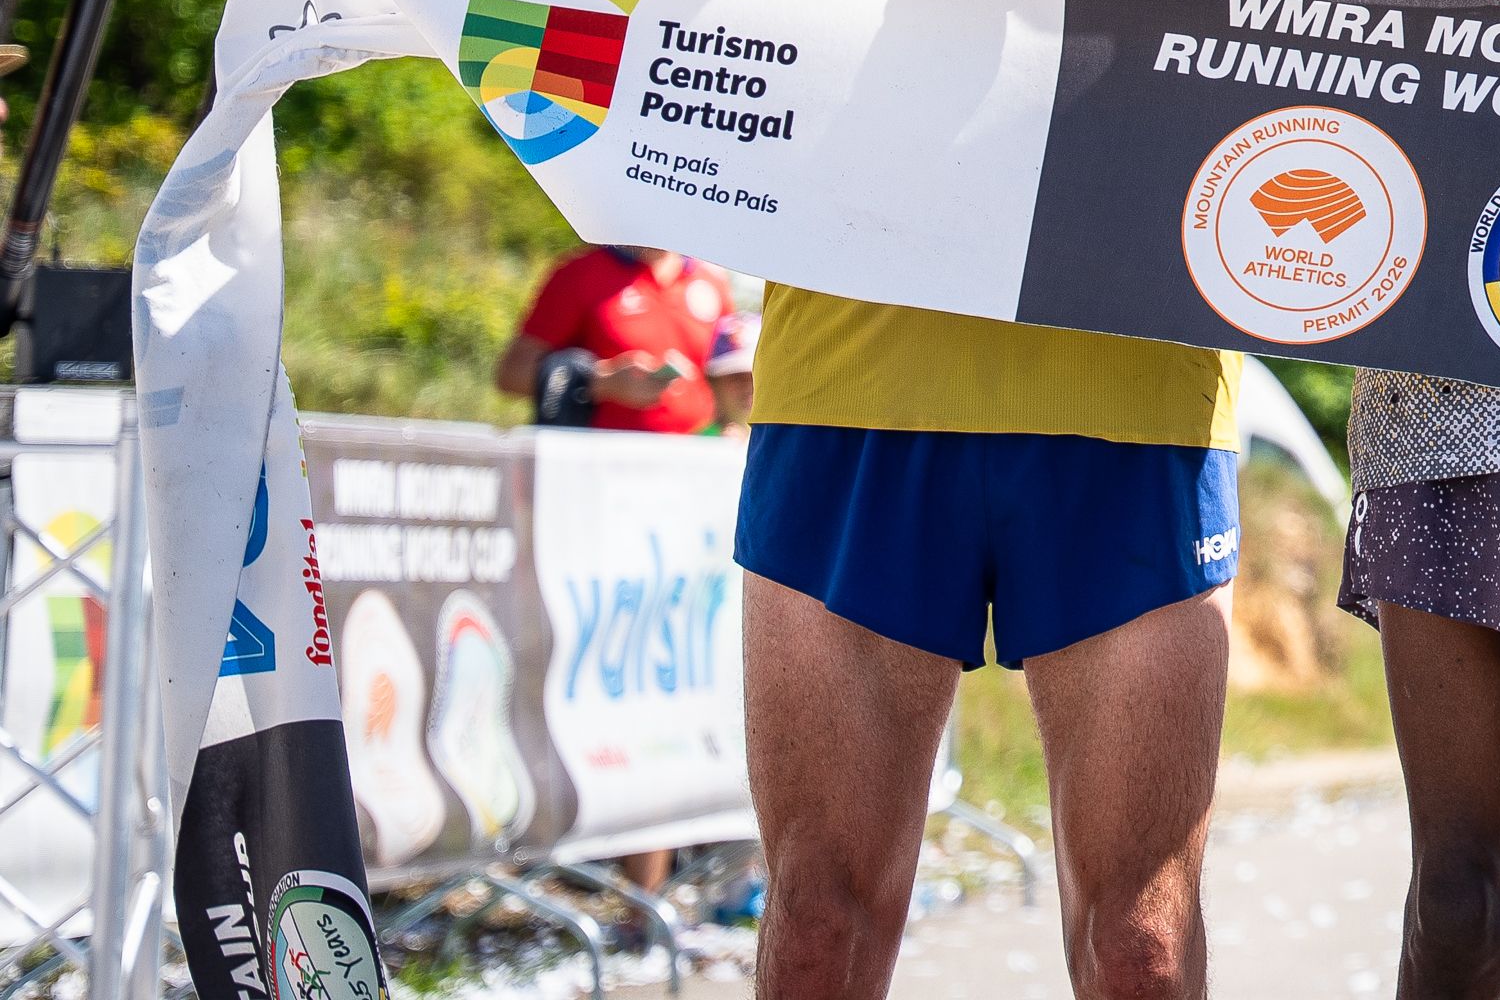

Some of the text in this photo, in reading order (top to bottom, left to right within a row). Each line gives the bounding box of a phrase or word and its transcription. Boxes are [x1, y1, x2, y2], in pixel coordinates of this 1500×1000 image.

[659, 20, 798, 66] Turismo
[648, 57, 767, 98] Centro
[1153, 32, 1421, 105] RUNNING
[640, 91, 795, 143] Portugal
[631, 141, 719, 177] Um país
[1193, 117, 1341, 230] MOUNTAIN RUNNING
[626, 164, 779, 214] dentro do País
[1243, 261, 1347, 288] ATHLETICS
[1264, 245, 1334, 268] WORLD
[1303, 255, 1408, 333] PERMIT 2026
[316, 912, 363, 979] Years
